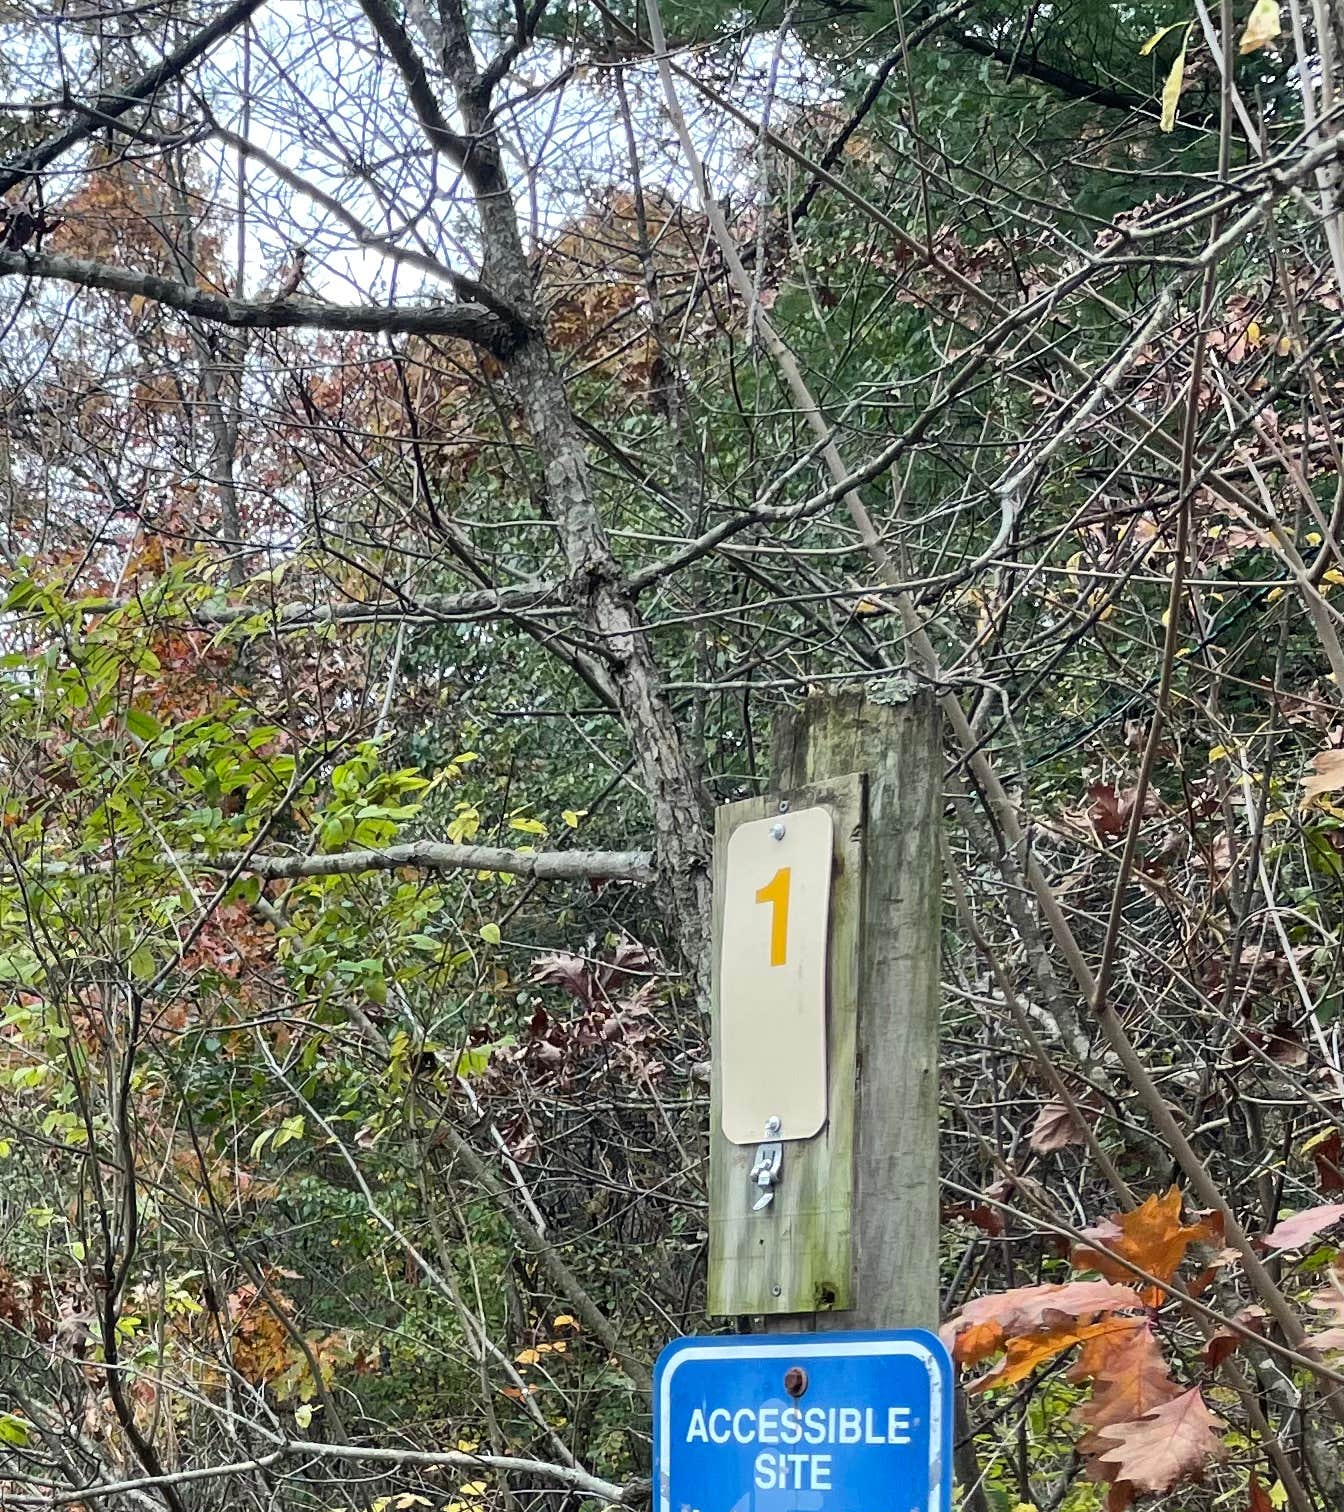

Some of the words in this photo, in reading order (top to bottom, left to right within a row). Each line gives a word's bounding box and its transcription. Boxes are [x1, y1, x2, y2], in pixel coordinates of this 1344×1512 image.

[755, 867, 791, 967] 1
[686, 1407, 911, 1444] ACCESSIBLE
[754, 1454, 832, 1490] SITE
